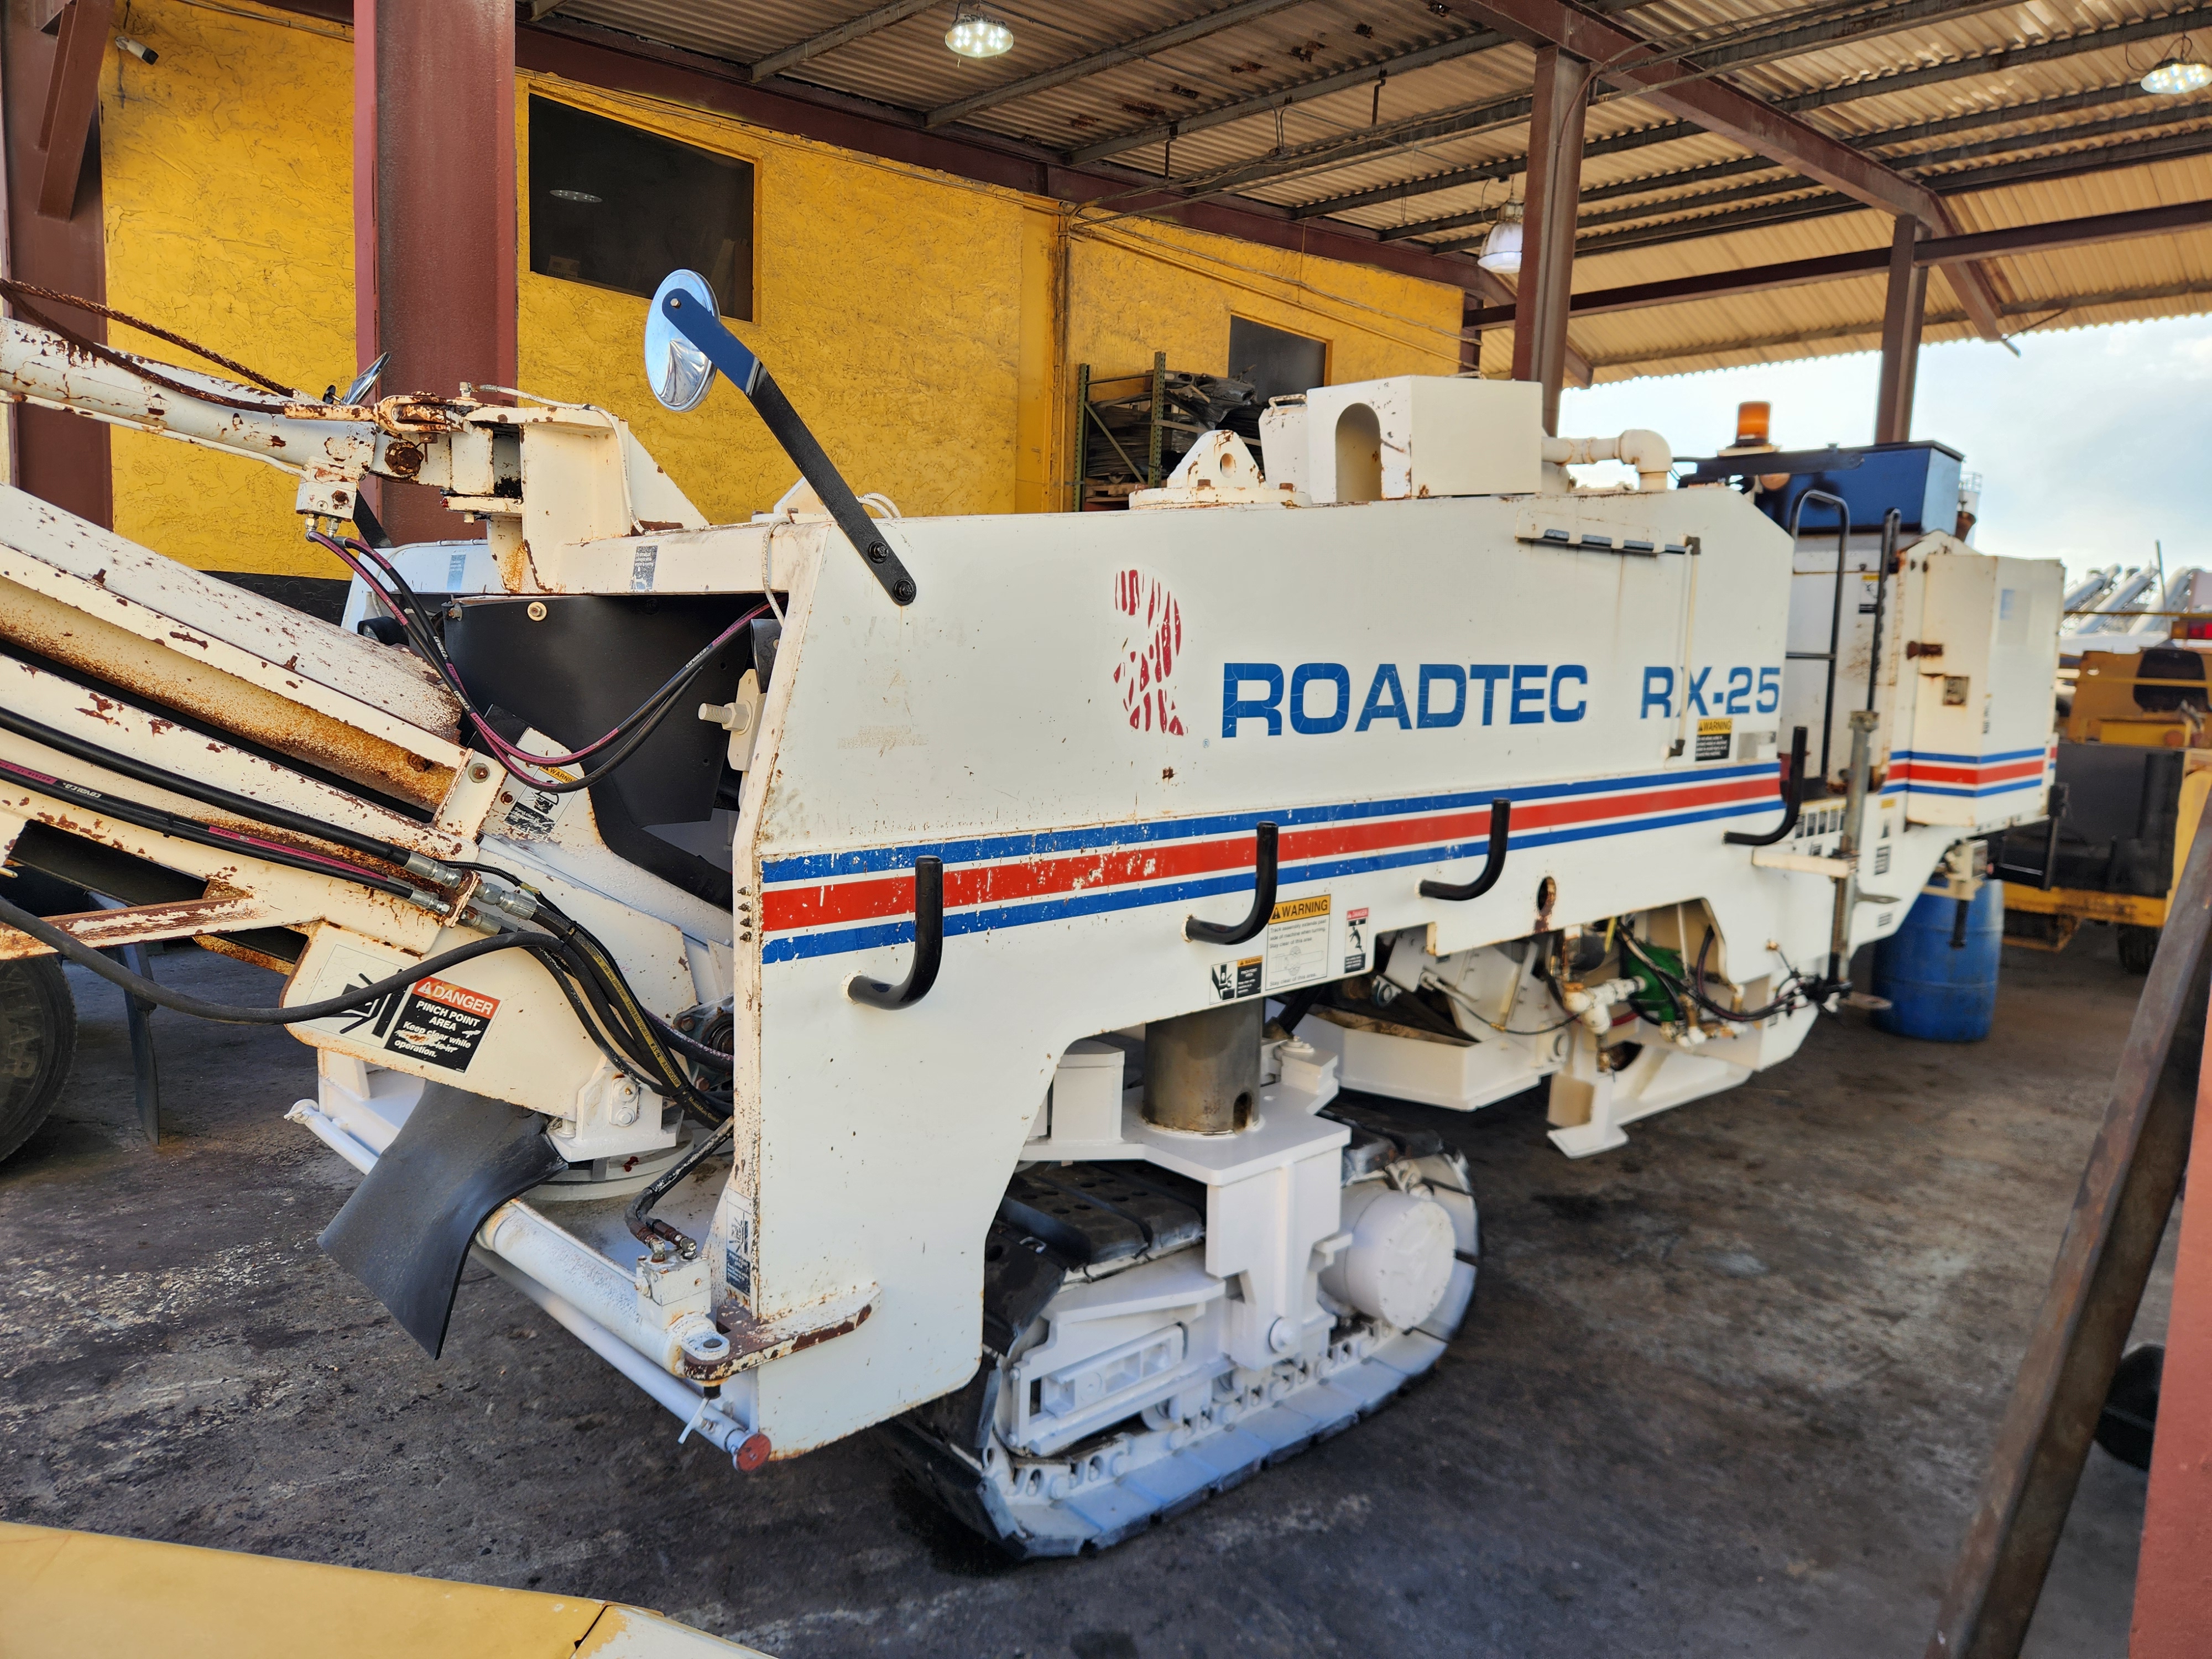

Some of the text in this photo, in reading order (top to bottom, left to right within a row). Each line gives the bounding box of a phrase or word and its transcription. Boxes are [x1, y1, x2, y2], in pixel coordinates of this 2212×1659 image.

[1222, 662, 1781, 738] ROADTEC RX-25
[1704, 721, 1732, 731] WARNING
[550, 768, 575, 783] WARNIN
[1282, 900, 1328, 917] WARNING
[432, 985, 494, 1015] DANGER
[416, 1001, 481, 1027] PINCH POINT
[429, 1016, 457, 1031] AREA
[403, 1022, 426, 1035] Keep
[426, 1027, 450, 1041] clear
[450, 1036, 472, 1048] while
[394, 1040, 437, 1058] operation.
[661, 1060, 681, 1087] AEROQUIP
